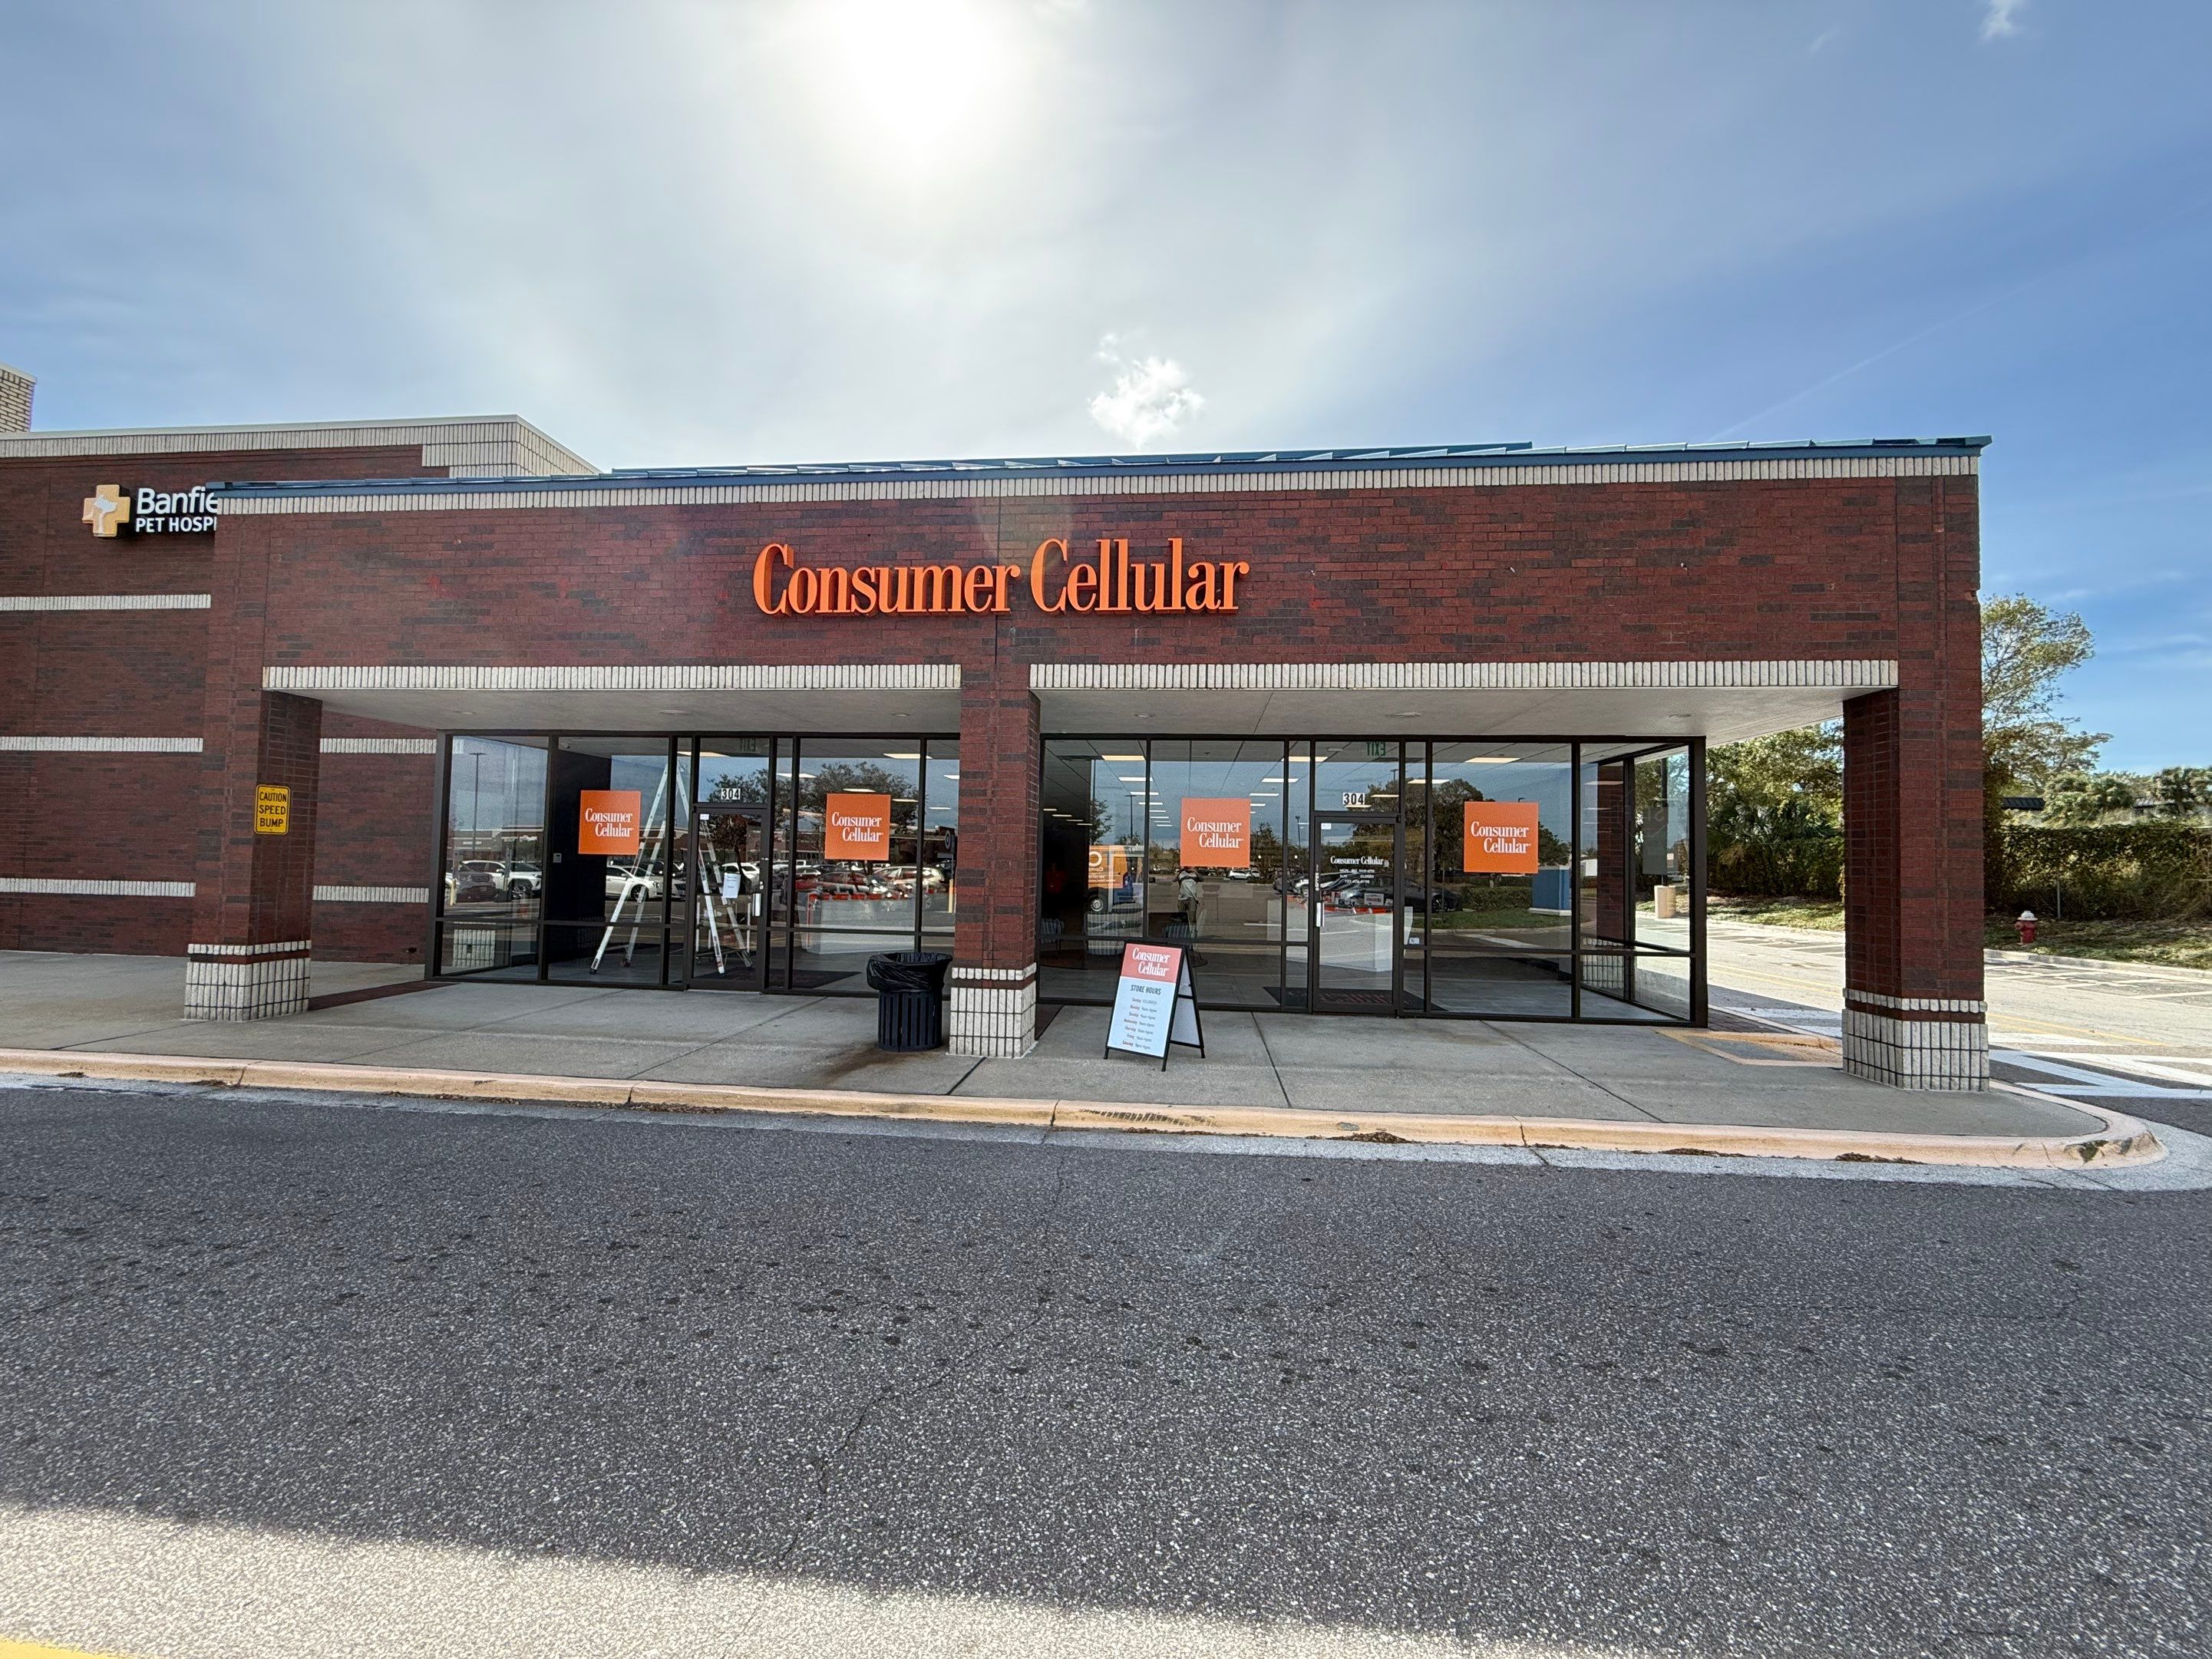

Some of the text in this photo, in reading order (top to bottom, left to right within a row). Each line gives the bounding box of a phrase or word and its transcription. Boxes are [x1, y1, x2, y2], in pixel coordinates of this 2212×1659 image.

[136, 517, 165, 533] PET
[753, 538, 1250, 615] Consumer Cellular
[259, 791, 287, 802] CAUTION
[722, 789, 740, 800] 304
[1343, 793, 1364, 805] 304
[259, 804, 286, 815] SPEED
[585, 808, 633, 823] Consumer
[259, 817, 284, 828] BUMP
[831, 811, 883, 827] Consumer
[1187, 816, 1242, 833] Consumer
[595, 823, 633, 837] Cellular
[842, 826, 883, 843] Cellular
[1471, 821, 1530, 838] Consumer
[1199, 833, 1243, 849] Cellular
[1483, 837, 1530, 854] Cellular
[1330, 856, 1360, 865] Consumer
[1360, 856, 1384, 865] Cellular
[1132, 947, 1170, 964] Consumer
[1137, 961, 1169, 977] Cellular
[1130, 985, 1162, 995] STORE HOURS
